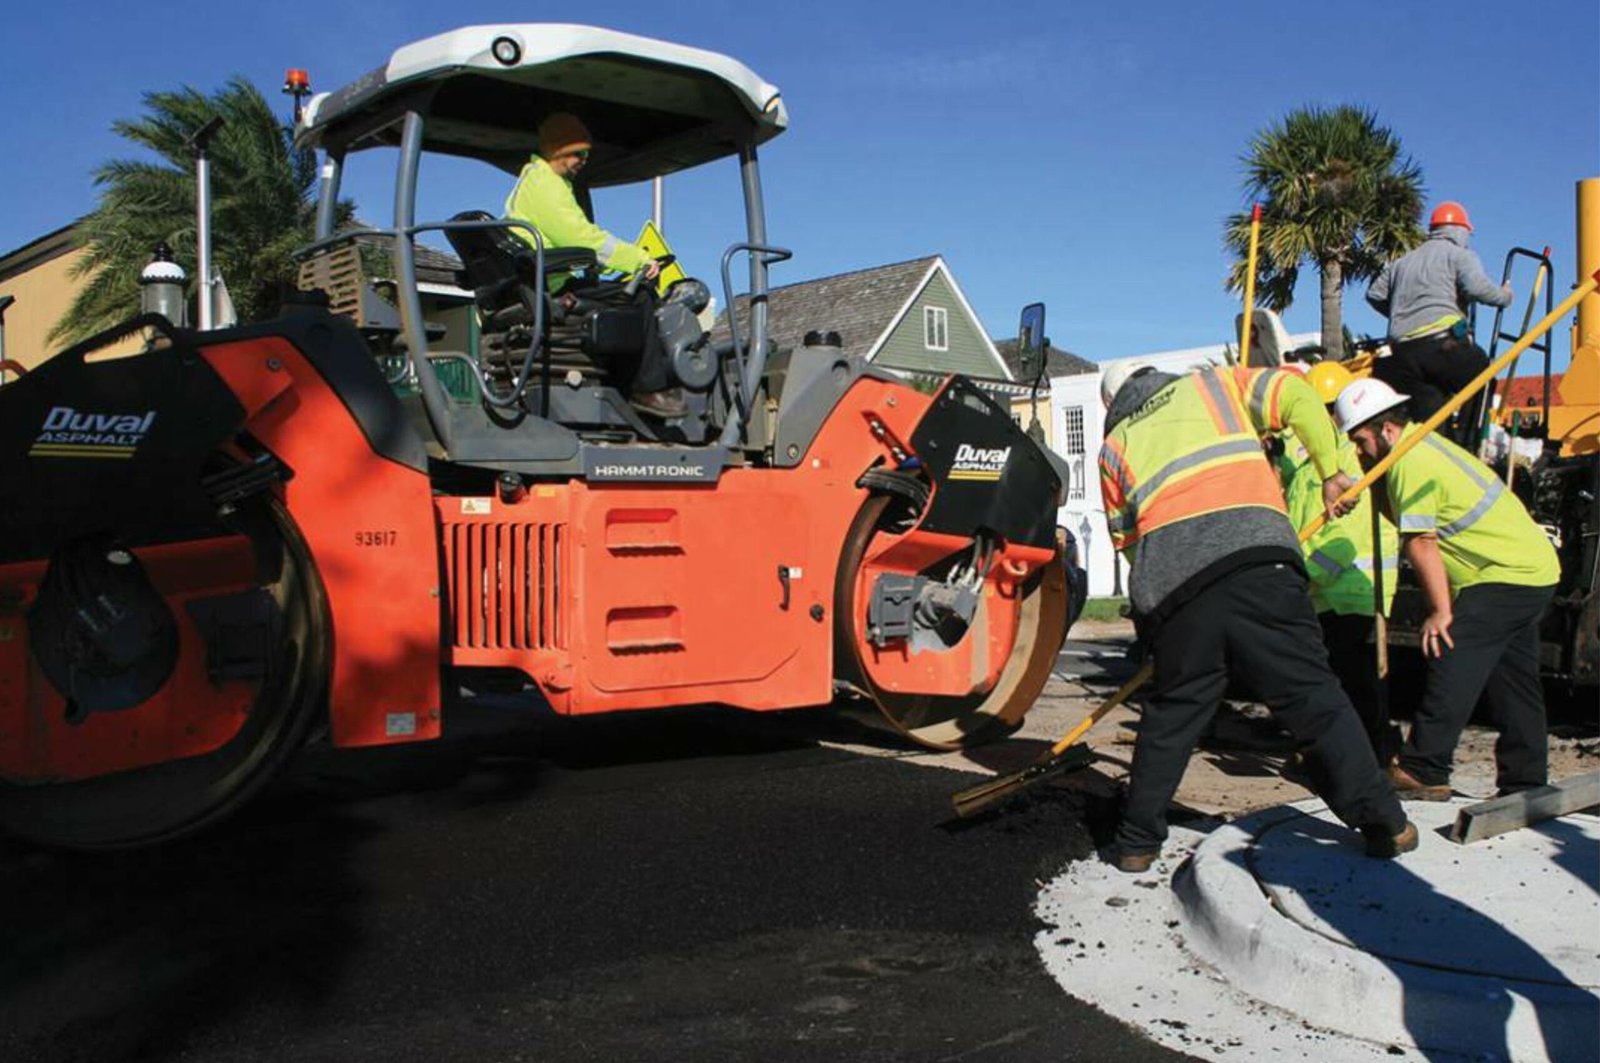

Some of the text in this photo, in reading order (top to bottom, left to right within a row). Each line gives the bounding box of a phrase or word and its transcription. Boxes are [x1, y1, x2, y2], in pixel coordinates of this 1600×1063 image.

[42, 406, 156, 433] Duval
[36, 432, 143, 445] ASPHALT
[954, 443, 1012, 463] Duval
[594, 465, 704, 476] HAMMTRONIC
[354, 530, 397, 546] 93617
